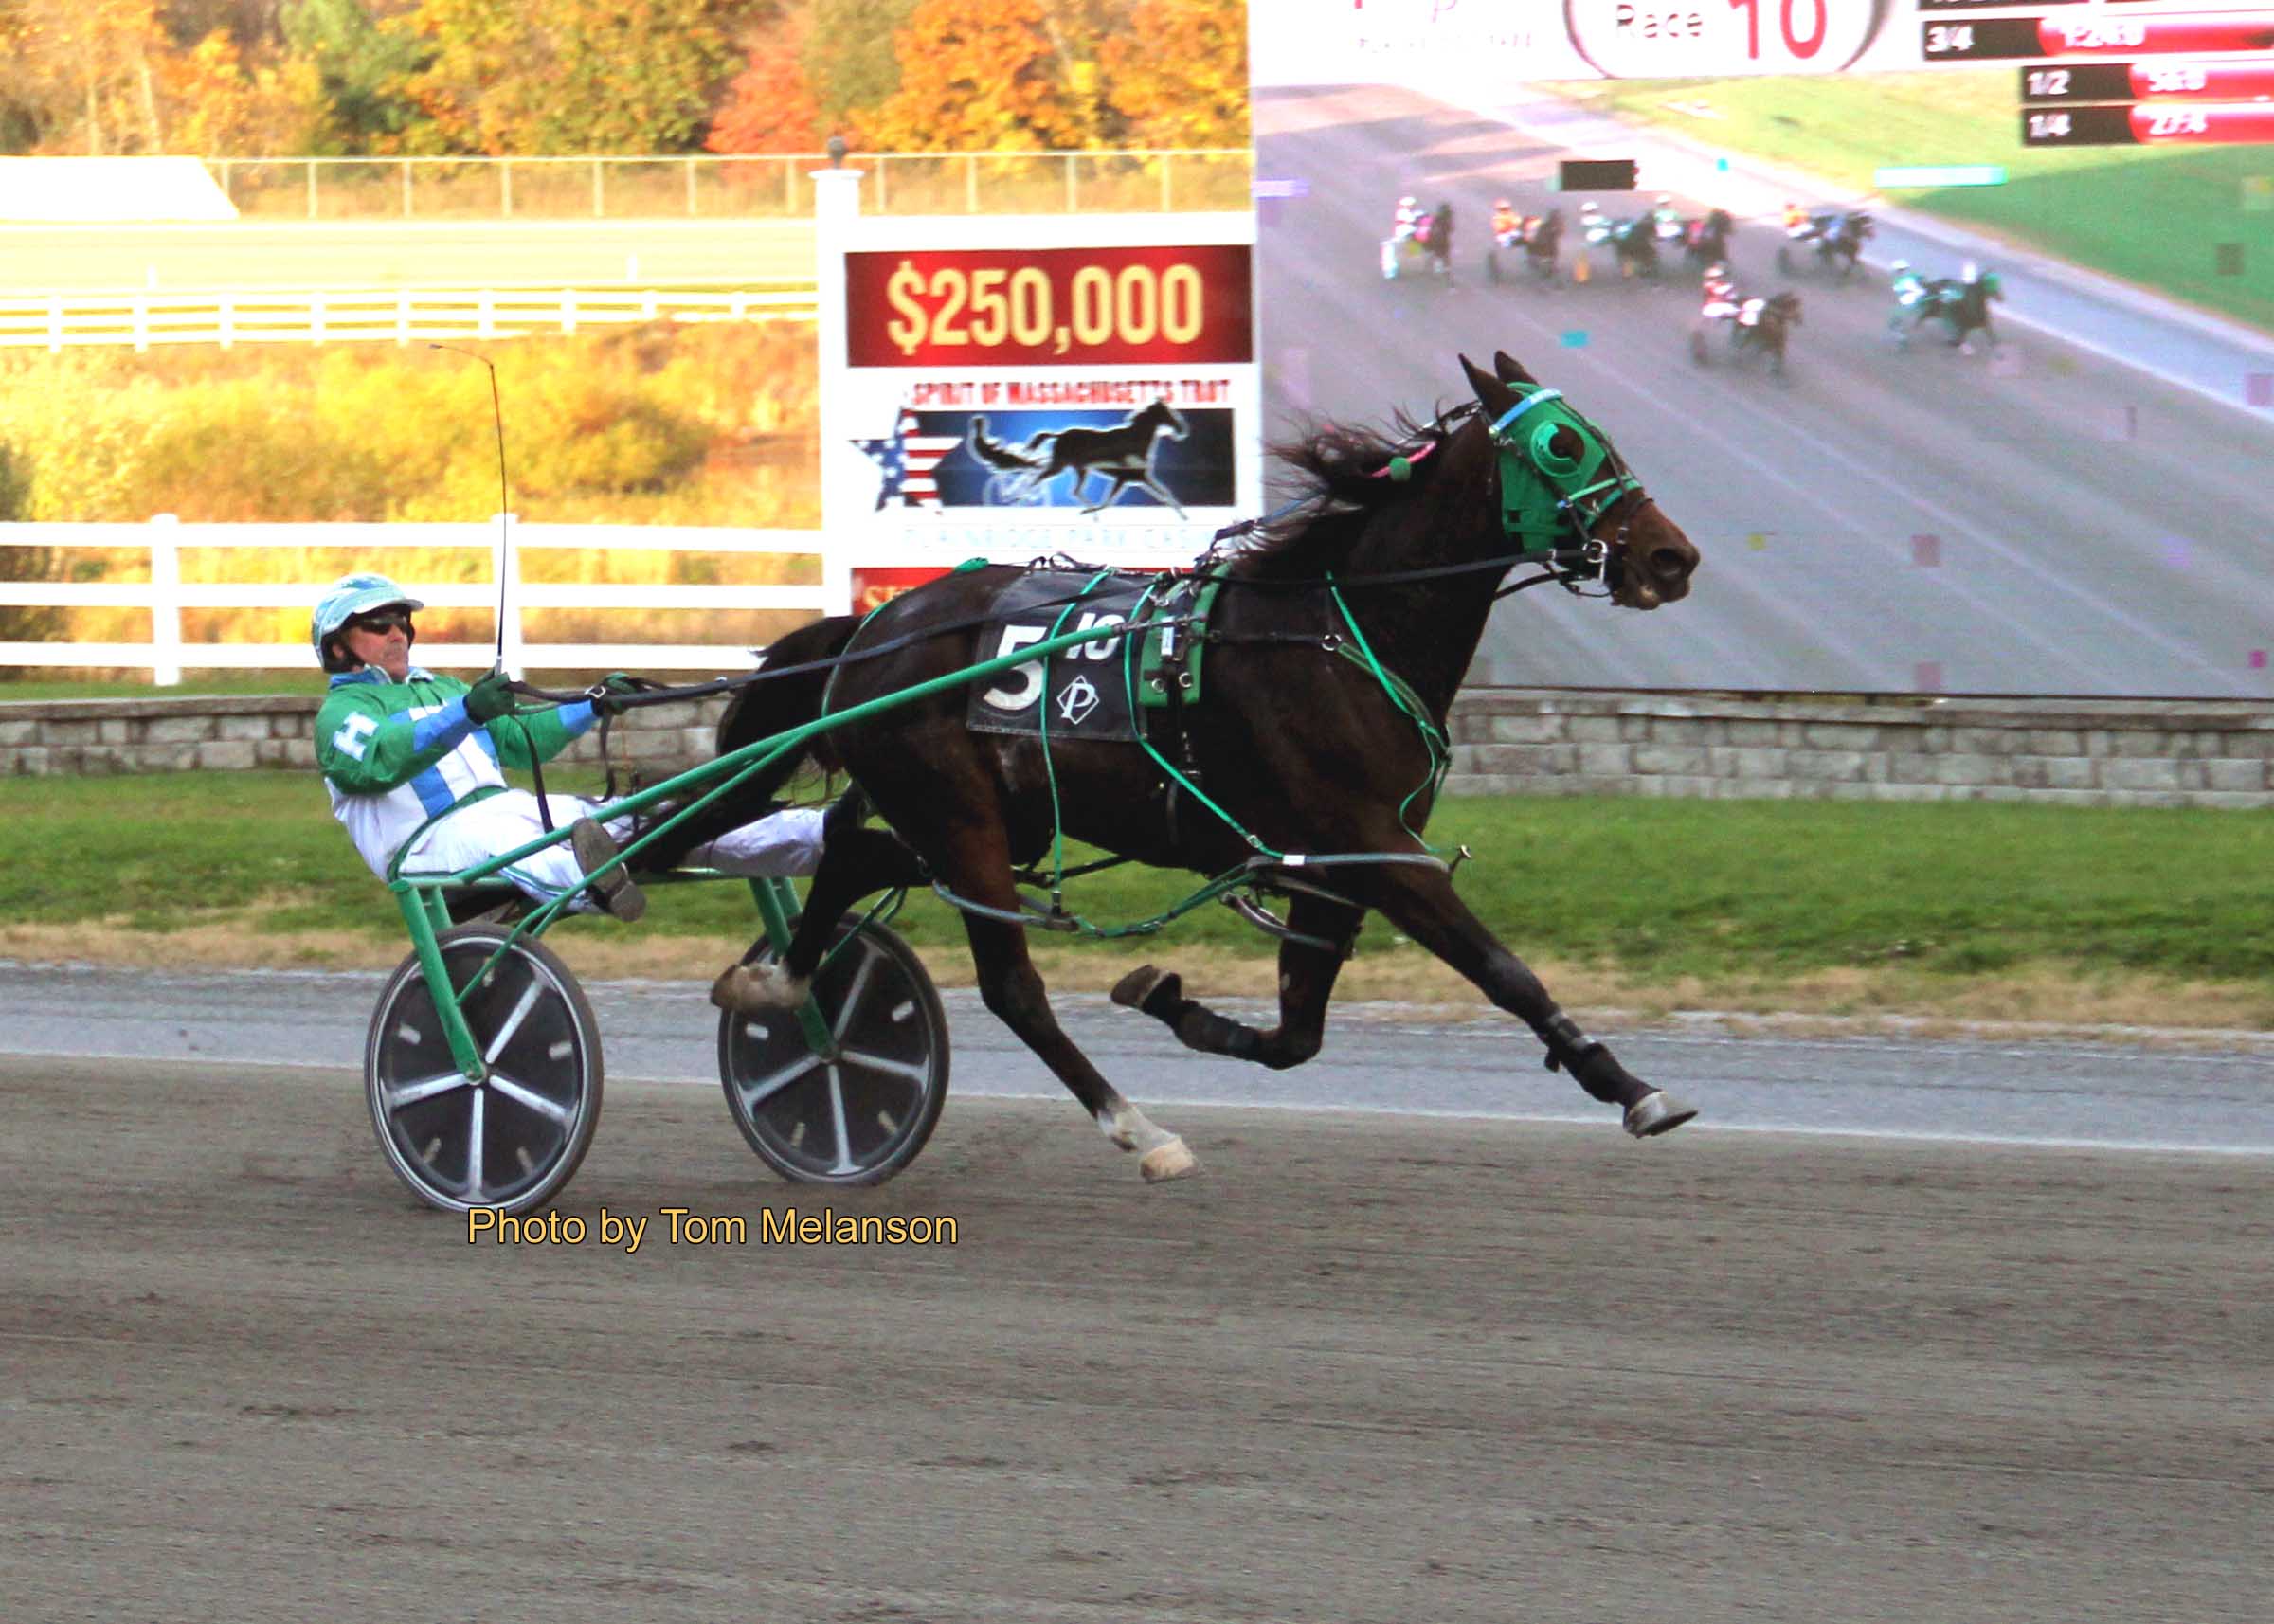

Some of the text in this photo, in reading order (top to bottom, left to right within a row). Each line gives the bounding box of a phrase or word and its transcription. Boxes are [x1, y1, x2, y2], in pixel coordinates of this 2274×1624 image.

[1615, 0, 1828, 60] Race 10
[886, 260, 1204, 356] $250,000
[1065, 612, 1126, 660] 10
[983, 624, 1047, 711] 5
[333, 711, 378, 762] H
